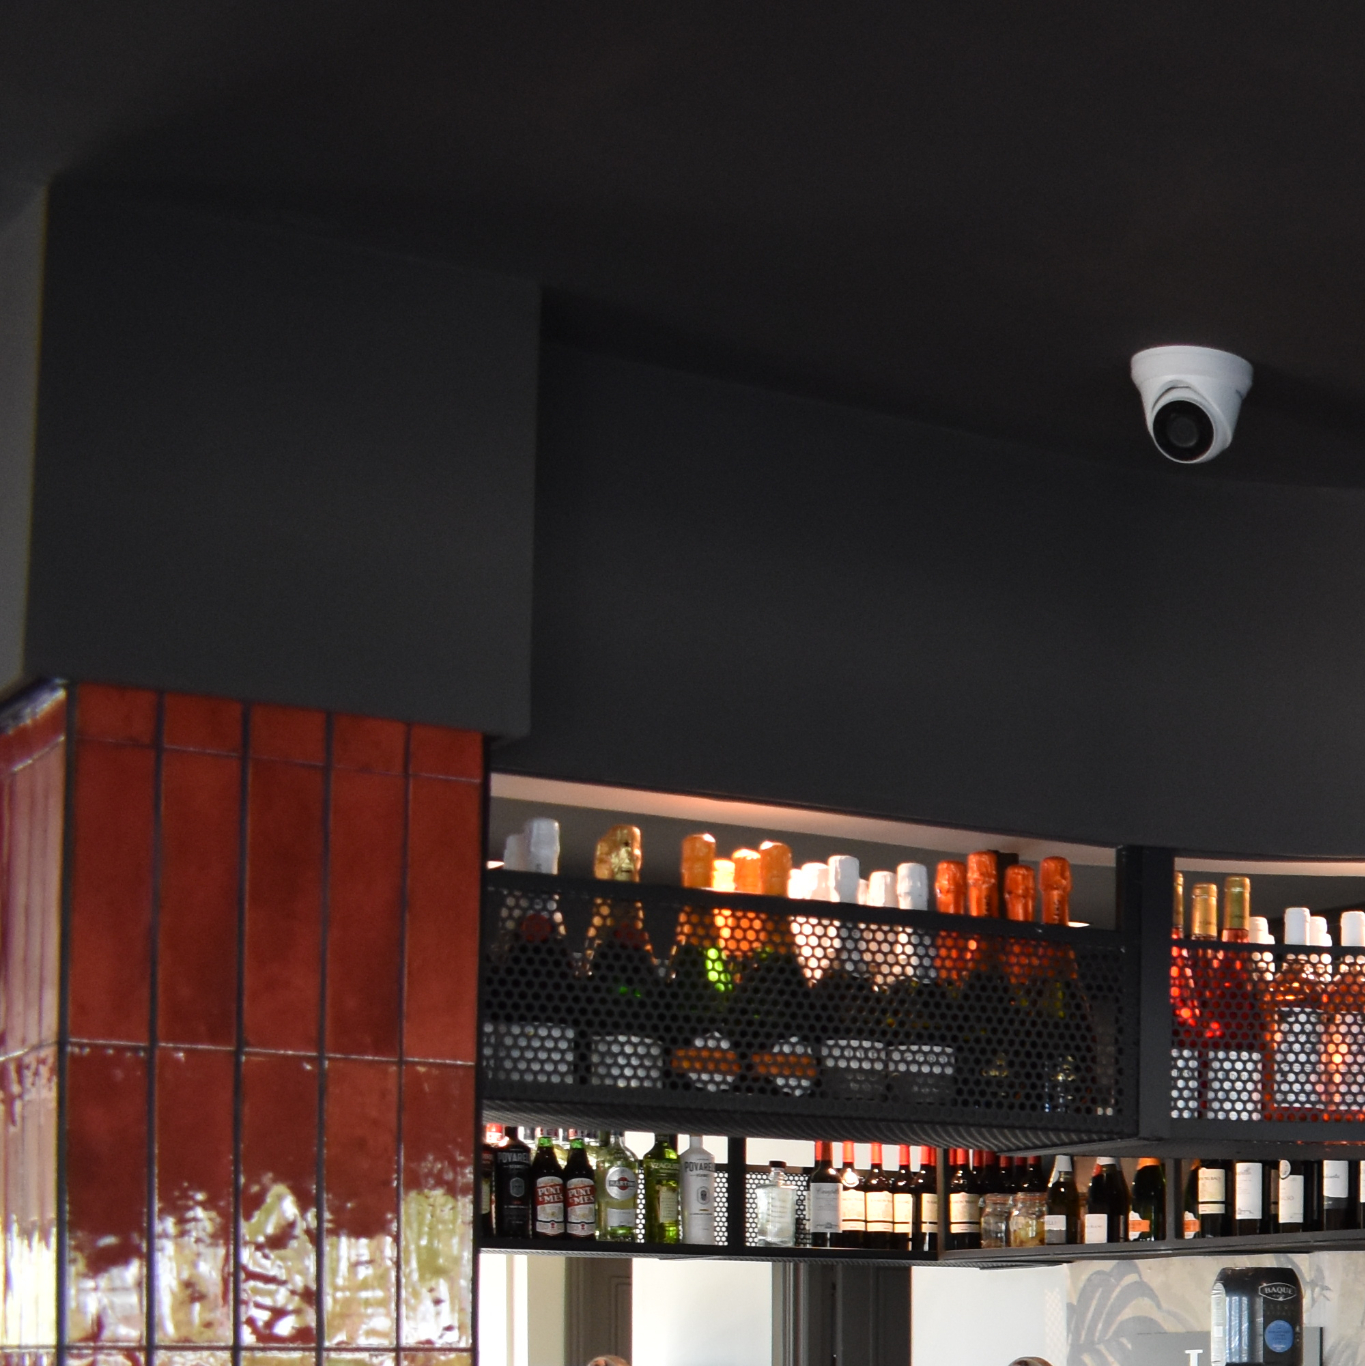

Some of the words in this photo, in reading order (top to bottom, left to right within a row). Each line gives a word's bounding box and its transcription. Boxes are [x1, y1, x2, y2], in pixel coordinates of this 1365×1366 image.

[537, 1186, 561, 1196] PUNT
[568, 1187, 591, 1198] PUNT
[545, 1194, 563, 1203] MES
[575, 1195, 594, 1205] MES
[1264, 1286, 1292, 1296] BAQUE
